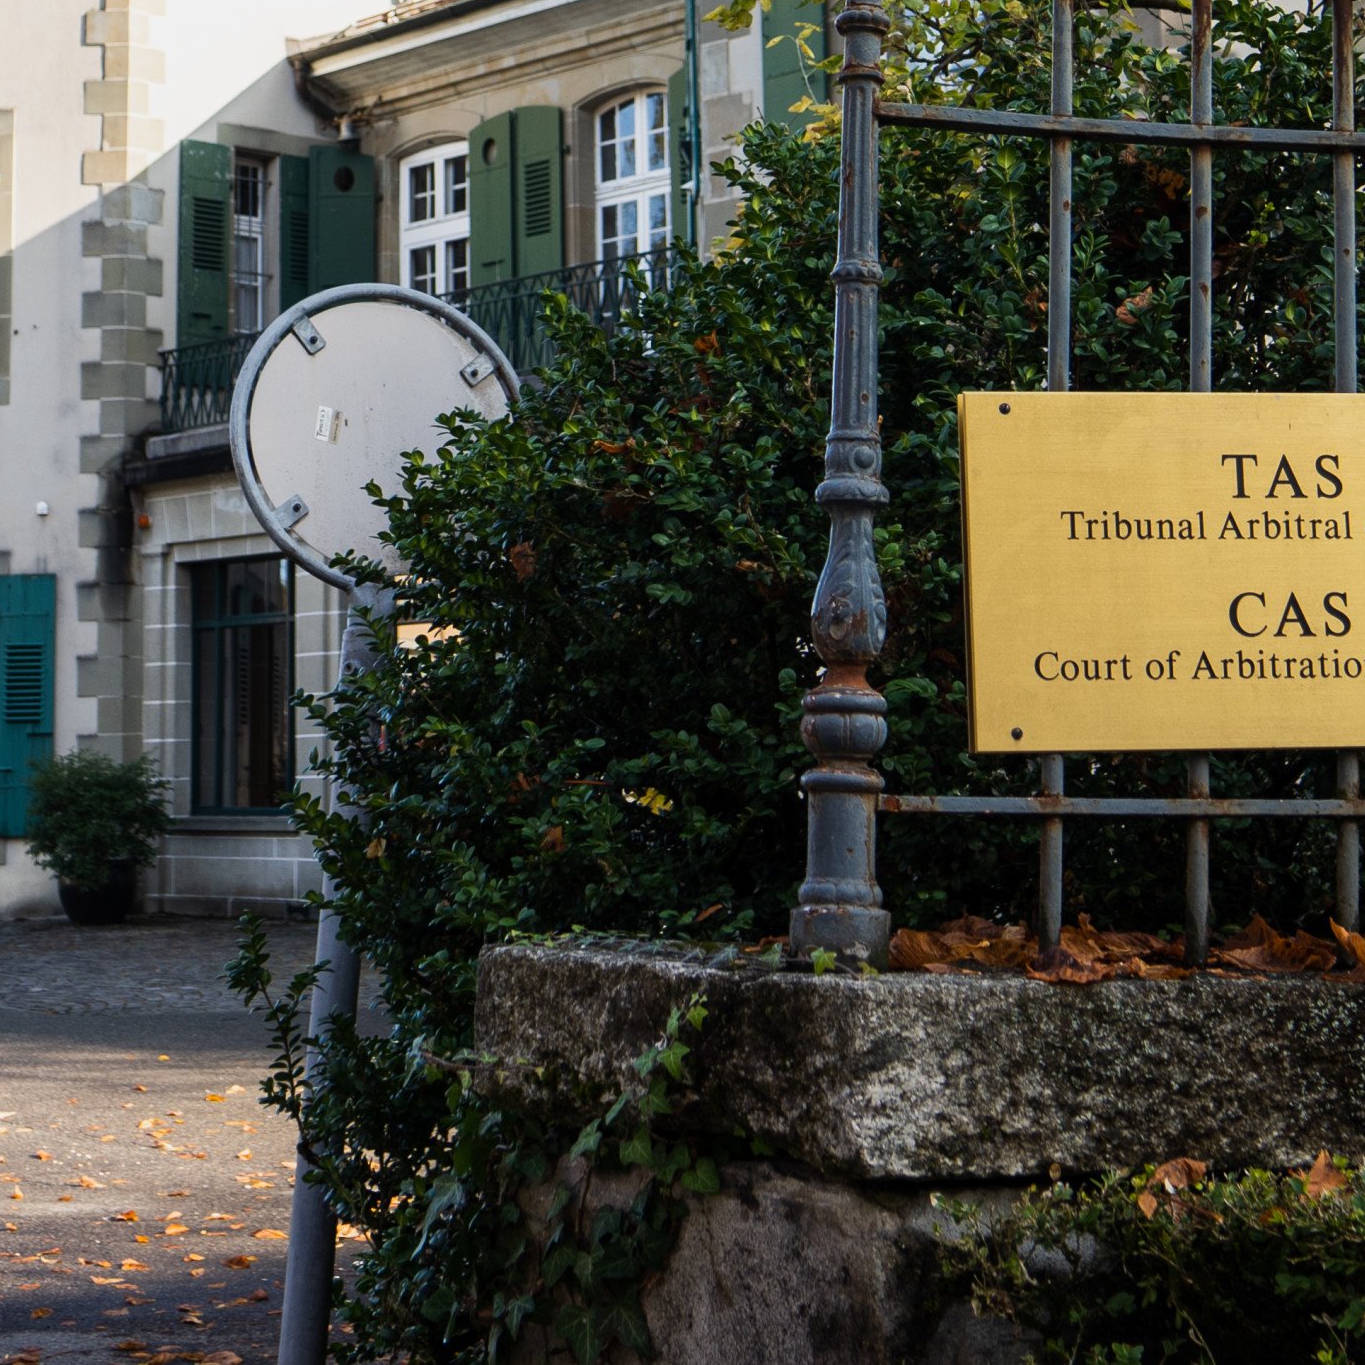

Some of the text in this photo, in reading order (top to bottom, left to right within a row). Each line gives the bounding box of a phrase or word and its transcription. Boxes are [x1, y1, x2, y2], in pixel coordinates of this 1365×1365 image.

[1222, 455, 1343, 499] TAS
[1061, 511, 1207, 540] Tribunal
[1219, 511, 1352, 540] Arbitral
[1229, 592, 1352, 637] CAS
[1034, 651, 1132, 681] Court
[1145, 650, 1180, 681] of
